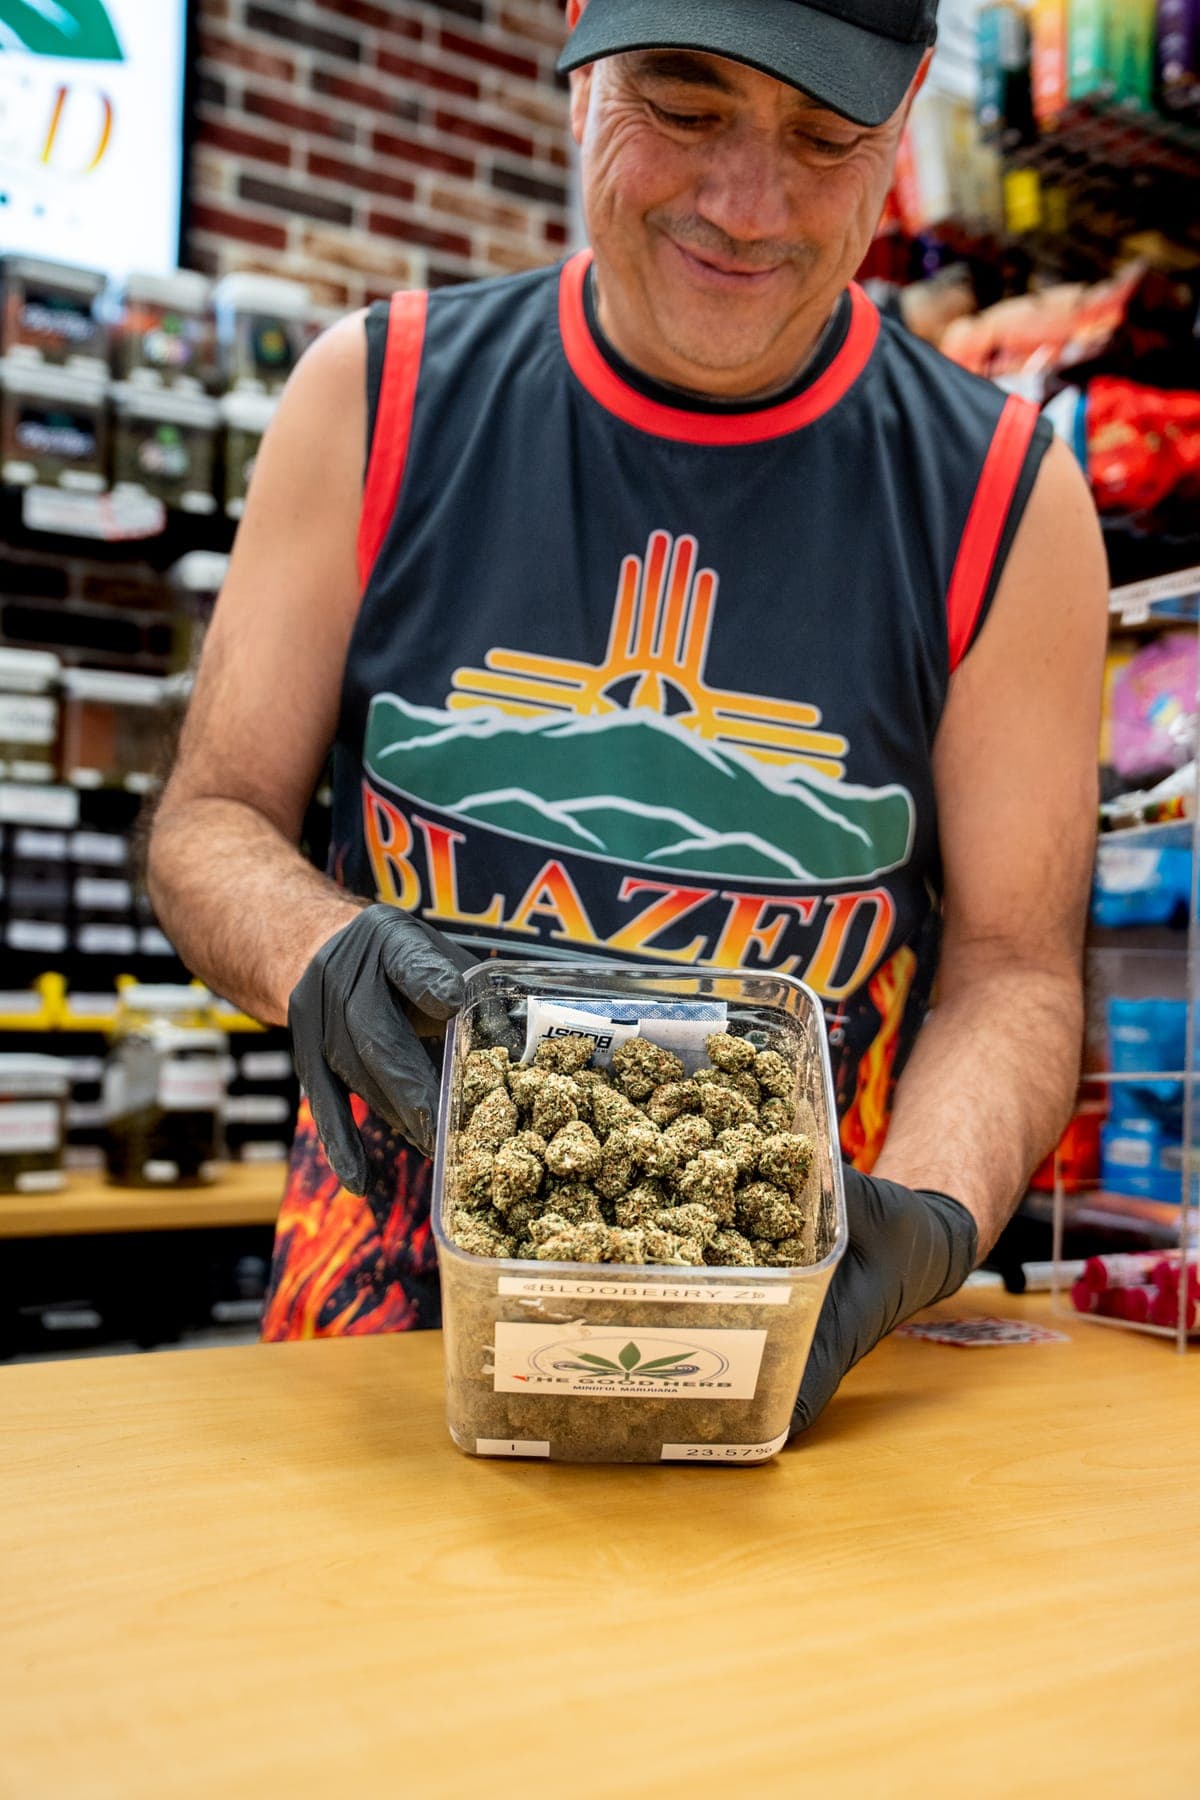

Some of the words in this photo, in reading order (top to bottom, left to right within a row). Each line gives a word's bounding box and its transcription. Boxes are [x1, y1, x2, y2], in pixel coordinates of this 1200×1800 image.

[361, 779, 896, 1000] BLAZED
[578, 1378, 655, 1386] GOOD
[686, 1447, 773, 1457] 23.57%
